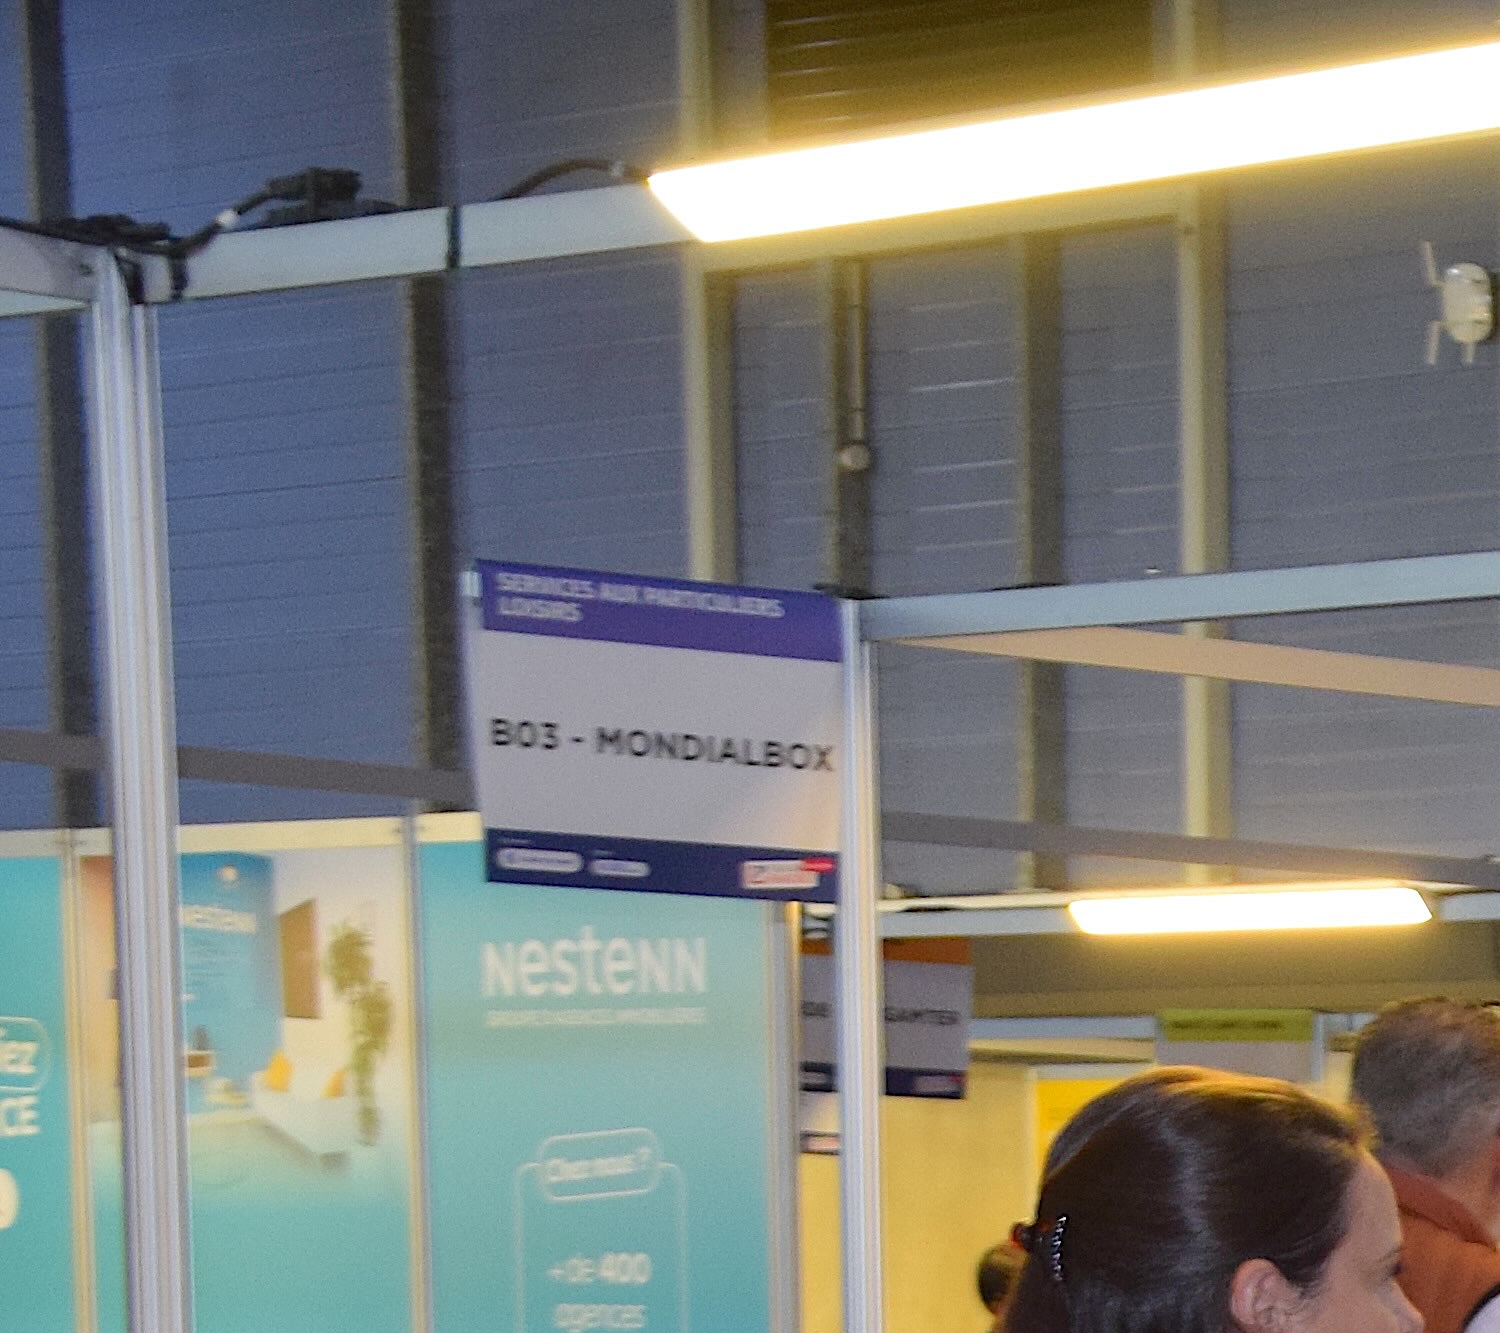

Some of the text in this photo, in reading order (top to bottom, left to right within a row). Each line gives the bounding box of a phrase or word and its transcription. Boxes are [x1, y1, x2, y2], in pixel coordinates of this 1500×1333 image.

[491, 718, 560, 750] B03
[597, 727, 834, 772] MONDIALBOX
[598, 1252, 652, 1285] 400
